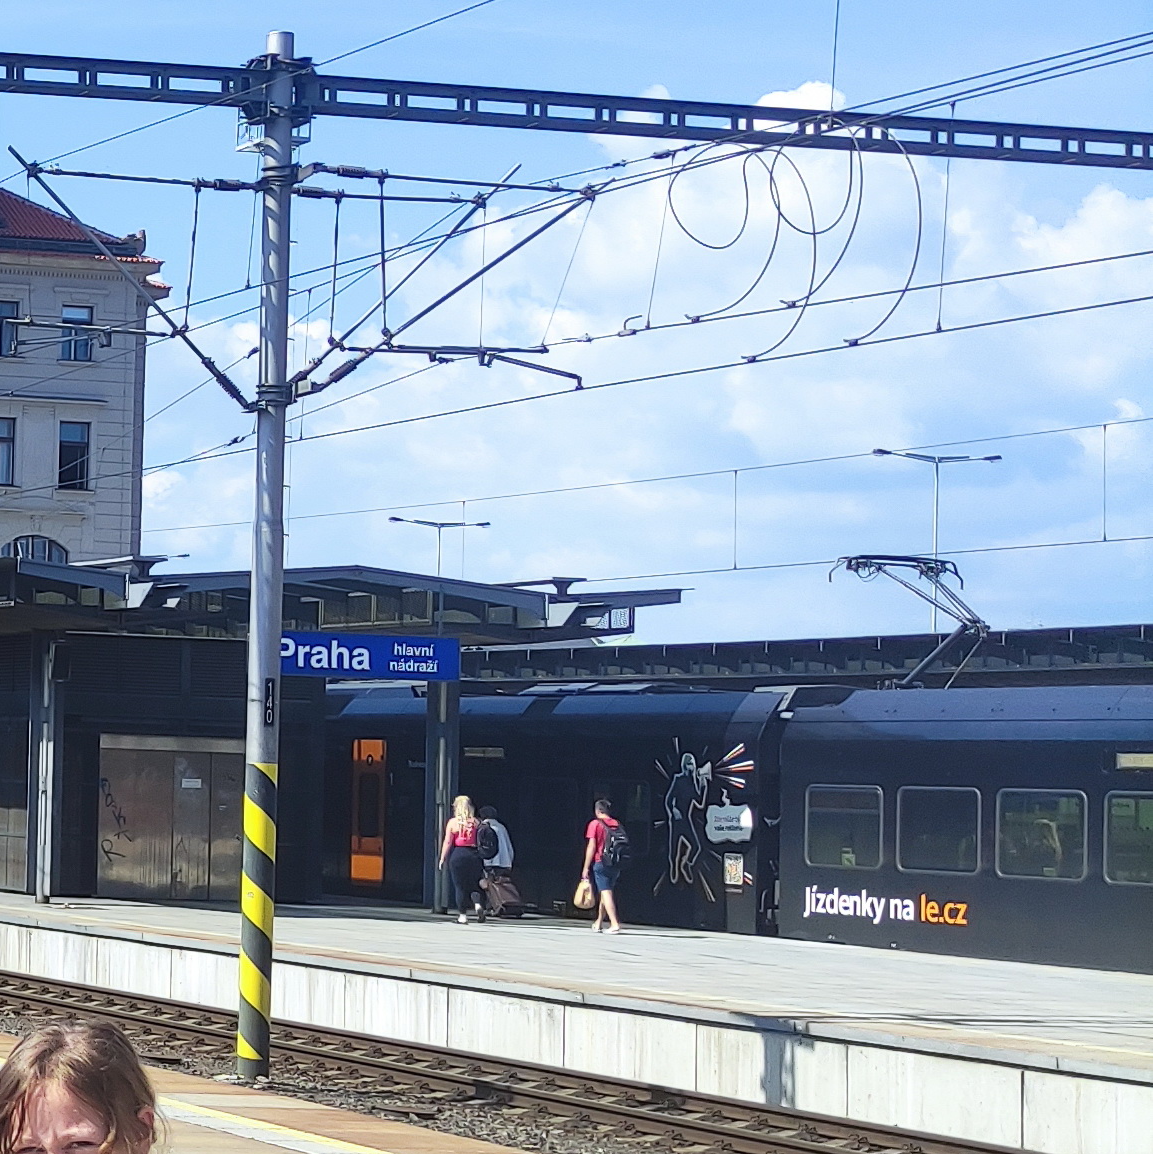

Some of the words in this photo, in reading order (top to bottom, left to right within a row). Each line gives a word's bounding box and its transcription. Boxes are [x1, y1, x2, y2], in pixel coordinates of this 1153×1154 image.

[393, 641, 435, 657] hlavní
[388, 659, 439, 674] nádraží
[265, 681, 274, 724] 140
[802, 884, 886, 925] Jízdenky
[889, 898, 915, 921] na
[920, 892, 968, 926] le.cz
